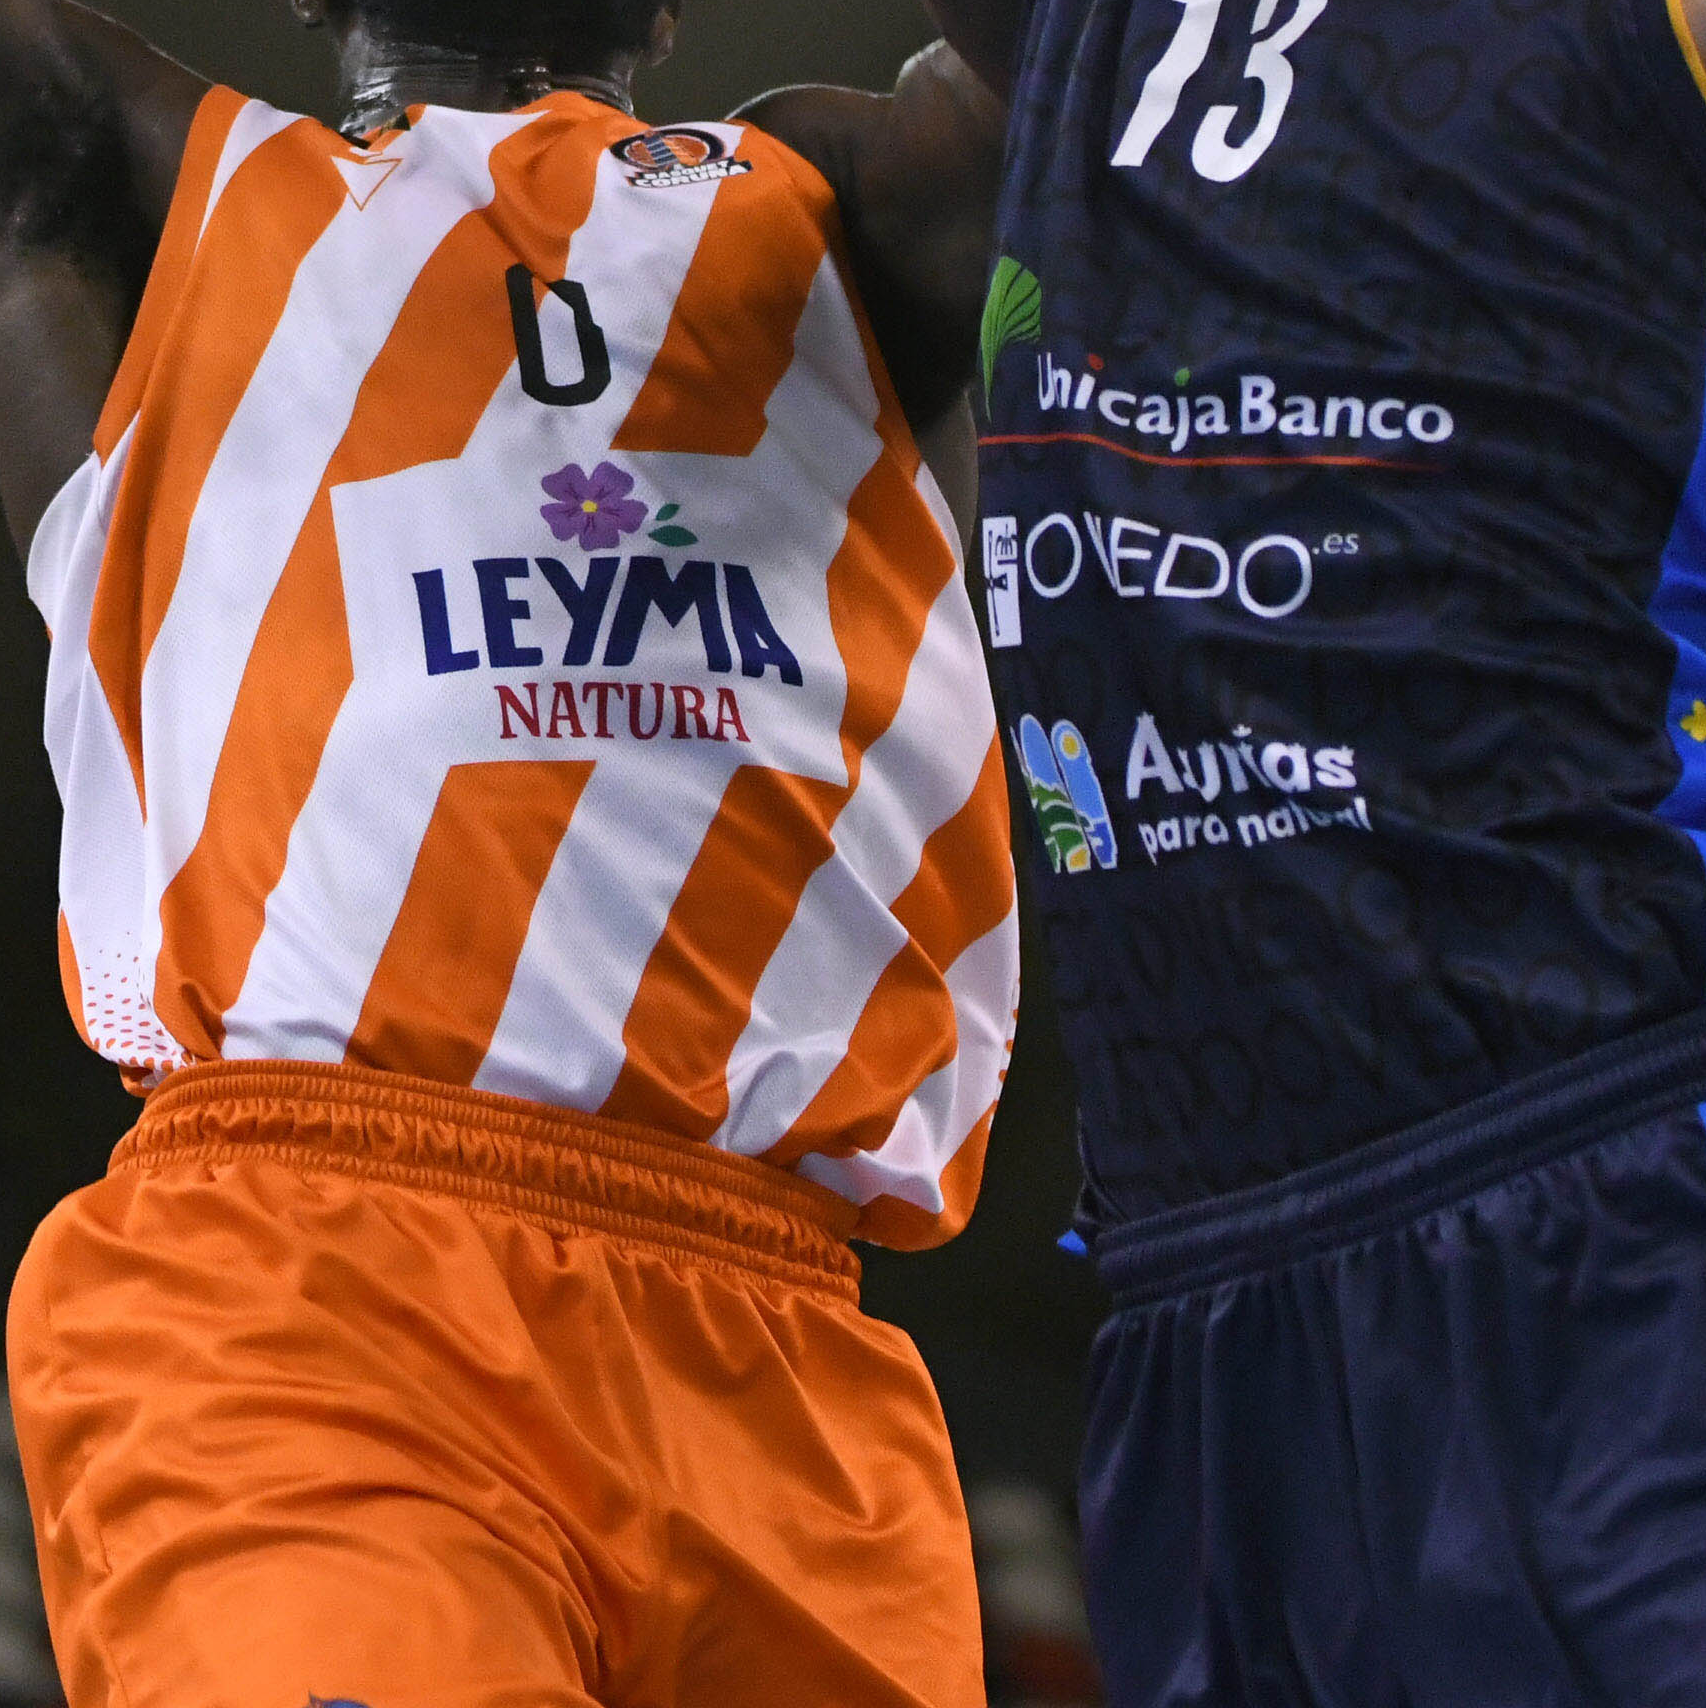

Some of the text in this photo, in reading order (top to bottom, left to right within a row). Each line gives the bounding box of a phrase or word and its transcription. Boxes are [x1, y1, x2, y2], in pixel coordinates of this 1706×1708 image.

[1037, 352, 1454, 452] Unicaja Banco
[413, 556, 804, 686] LEYMA
[498, 682, 753, 744] NATURA
